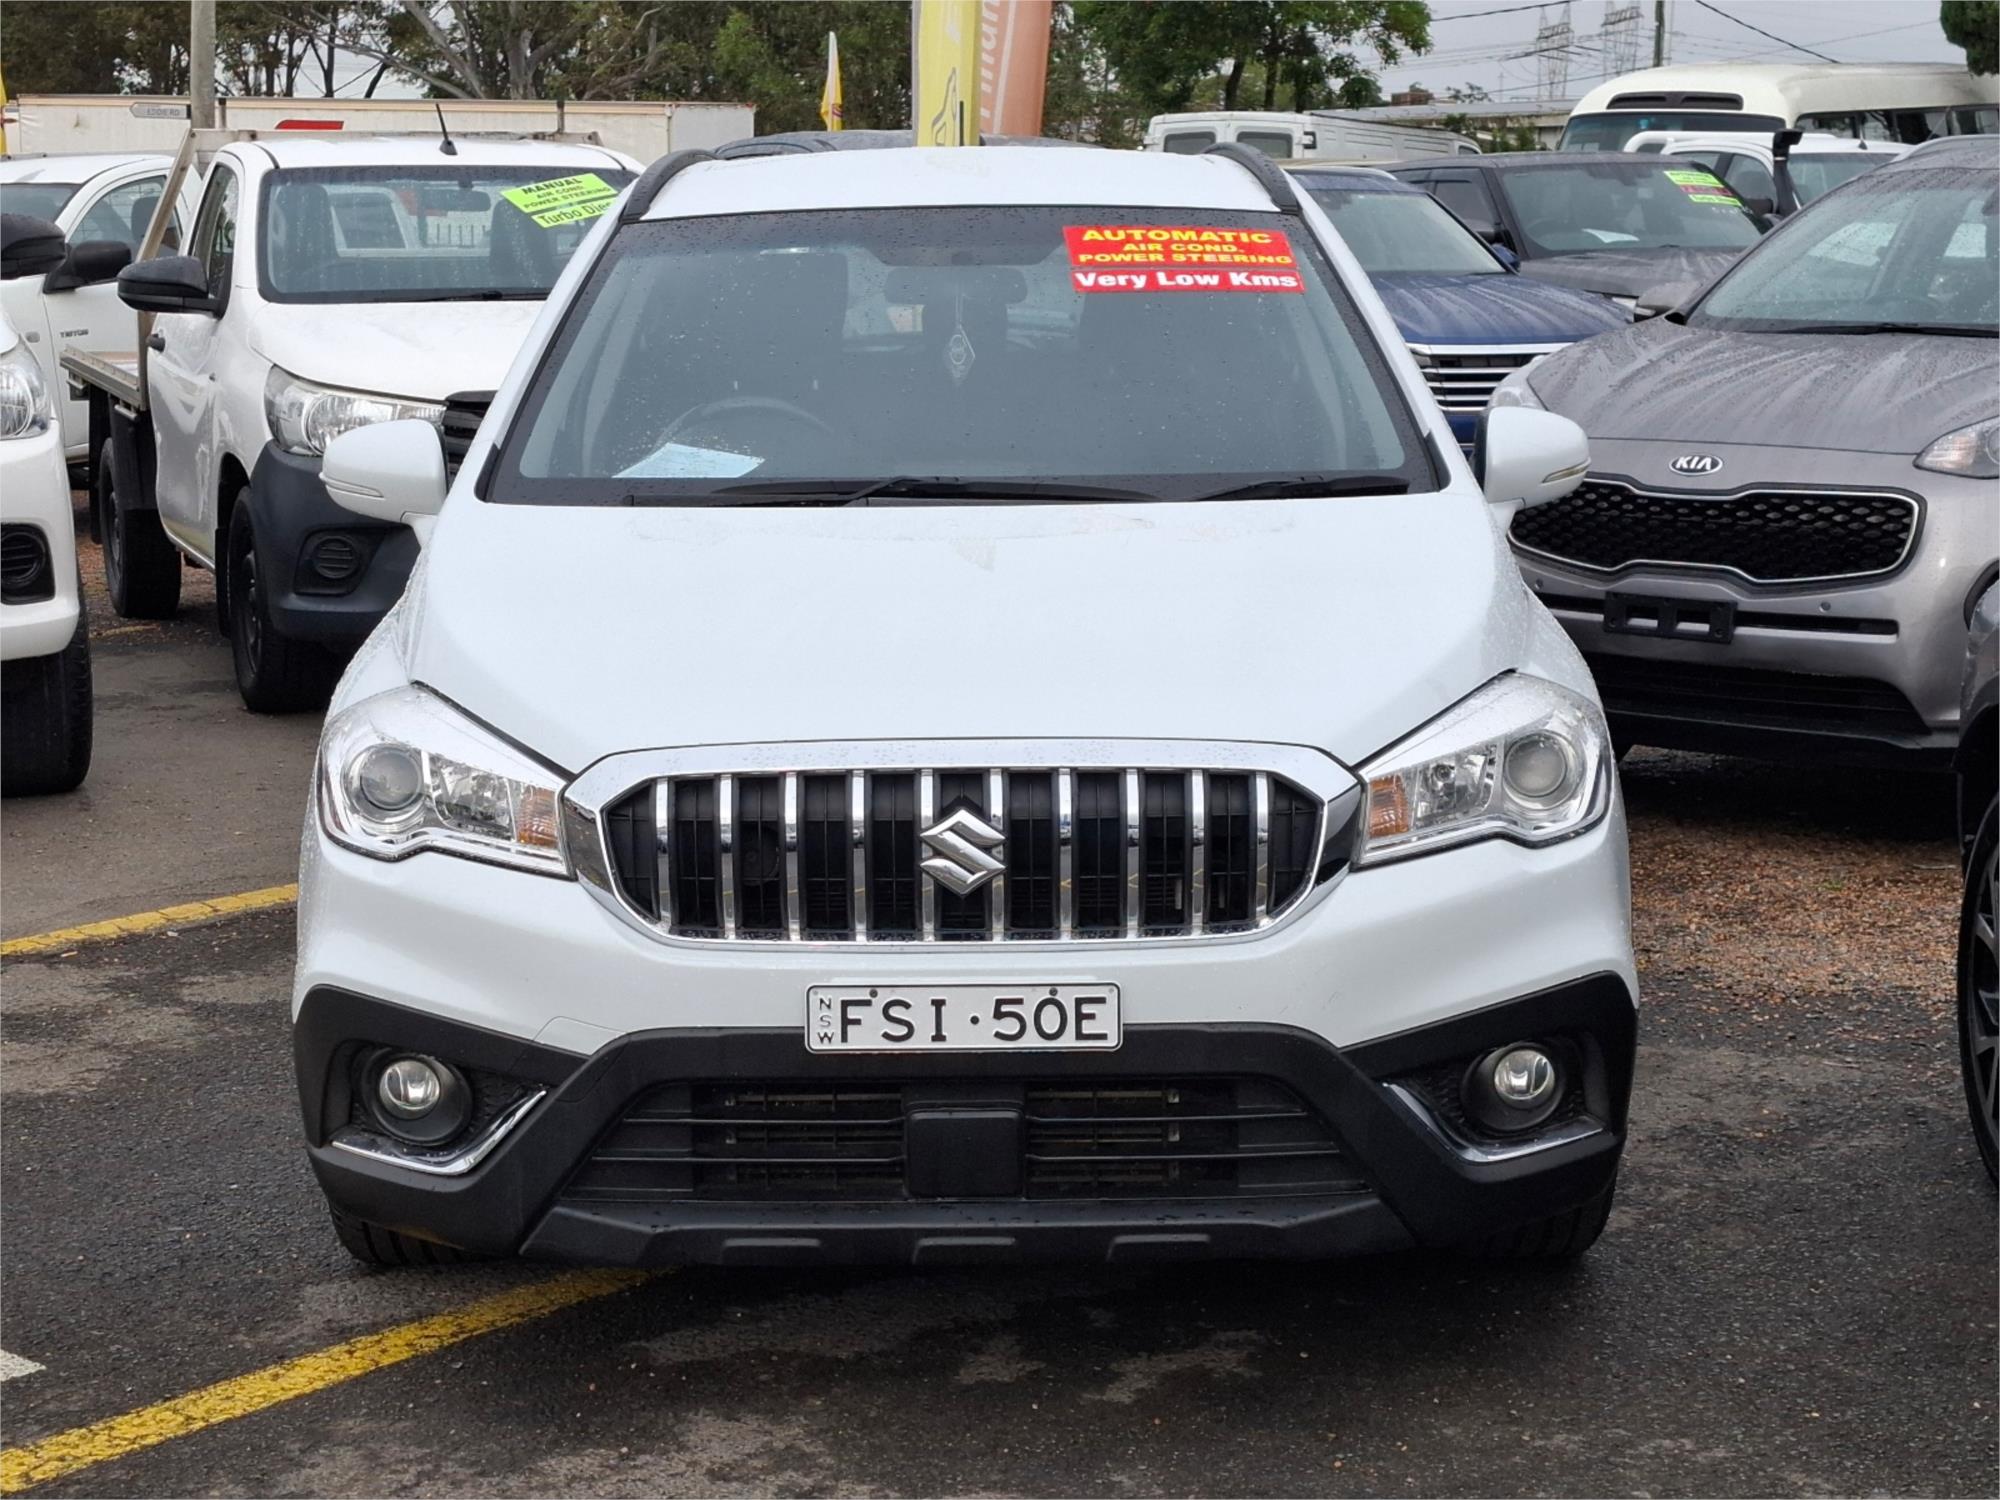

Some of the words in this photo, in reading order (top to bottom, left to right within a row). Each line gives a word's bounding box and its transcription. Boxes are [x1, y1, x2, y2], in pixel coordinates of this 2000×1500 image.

[521, 177, 583, 195] MANUAL
[523, 198, 561, 208] POWER
[562, 187, 611, 202] STEERING
[536, 190, 553, 199] AIR
[538, 208, 583, 225] Turbo
[1082, 229, 1272, 244] AUTOMATIC
[1123, 243, 1164, 252] AIR
[1171, 243, 1245, 253] COND.
[1079, 253, 1166, 263] POWER
[1172, 253, 1293, 264] STEERING
[1075, 271, 1147, 289] Very
[1157, 271, 1220, 287] Low
[1230, 272, 1298, 288] Kms
[1675, 455, 1712, 471] KIA
